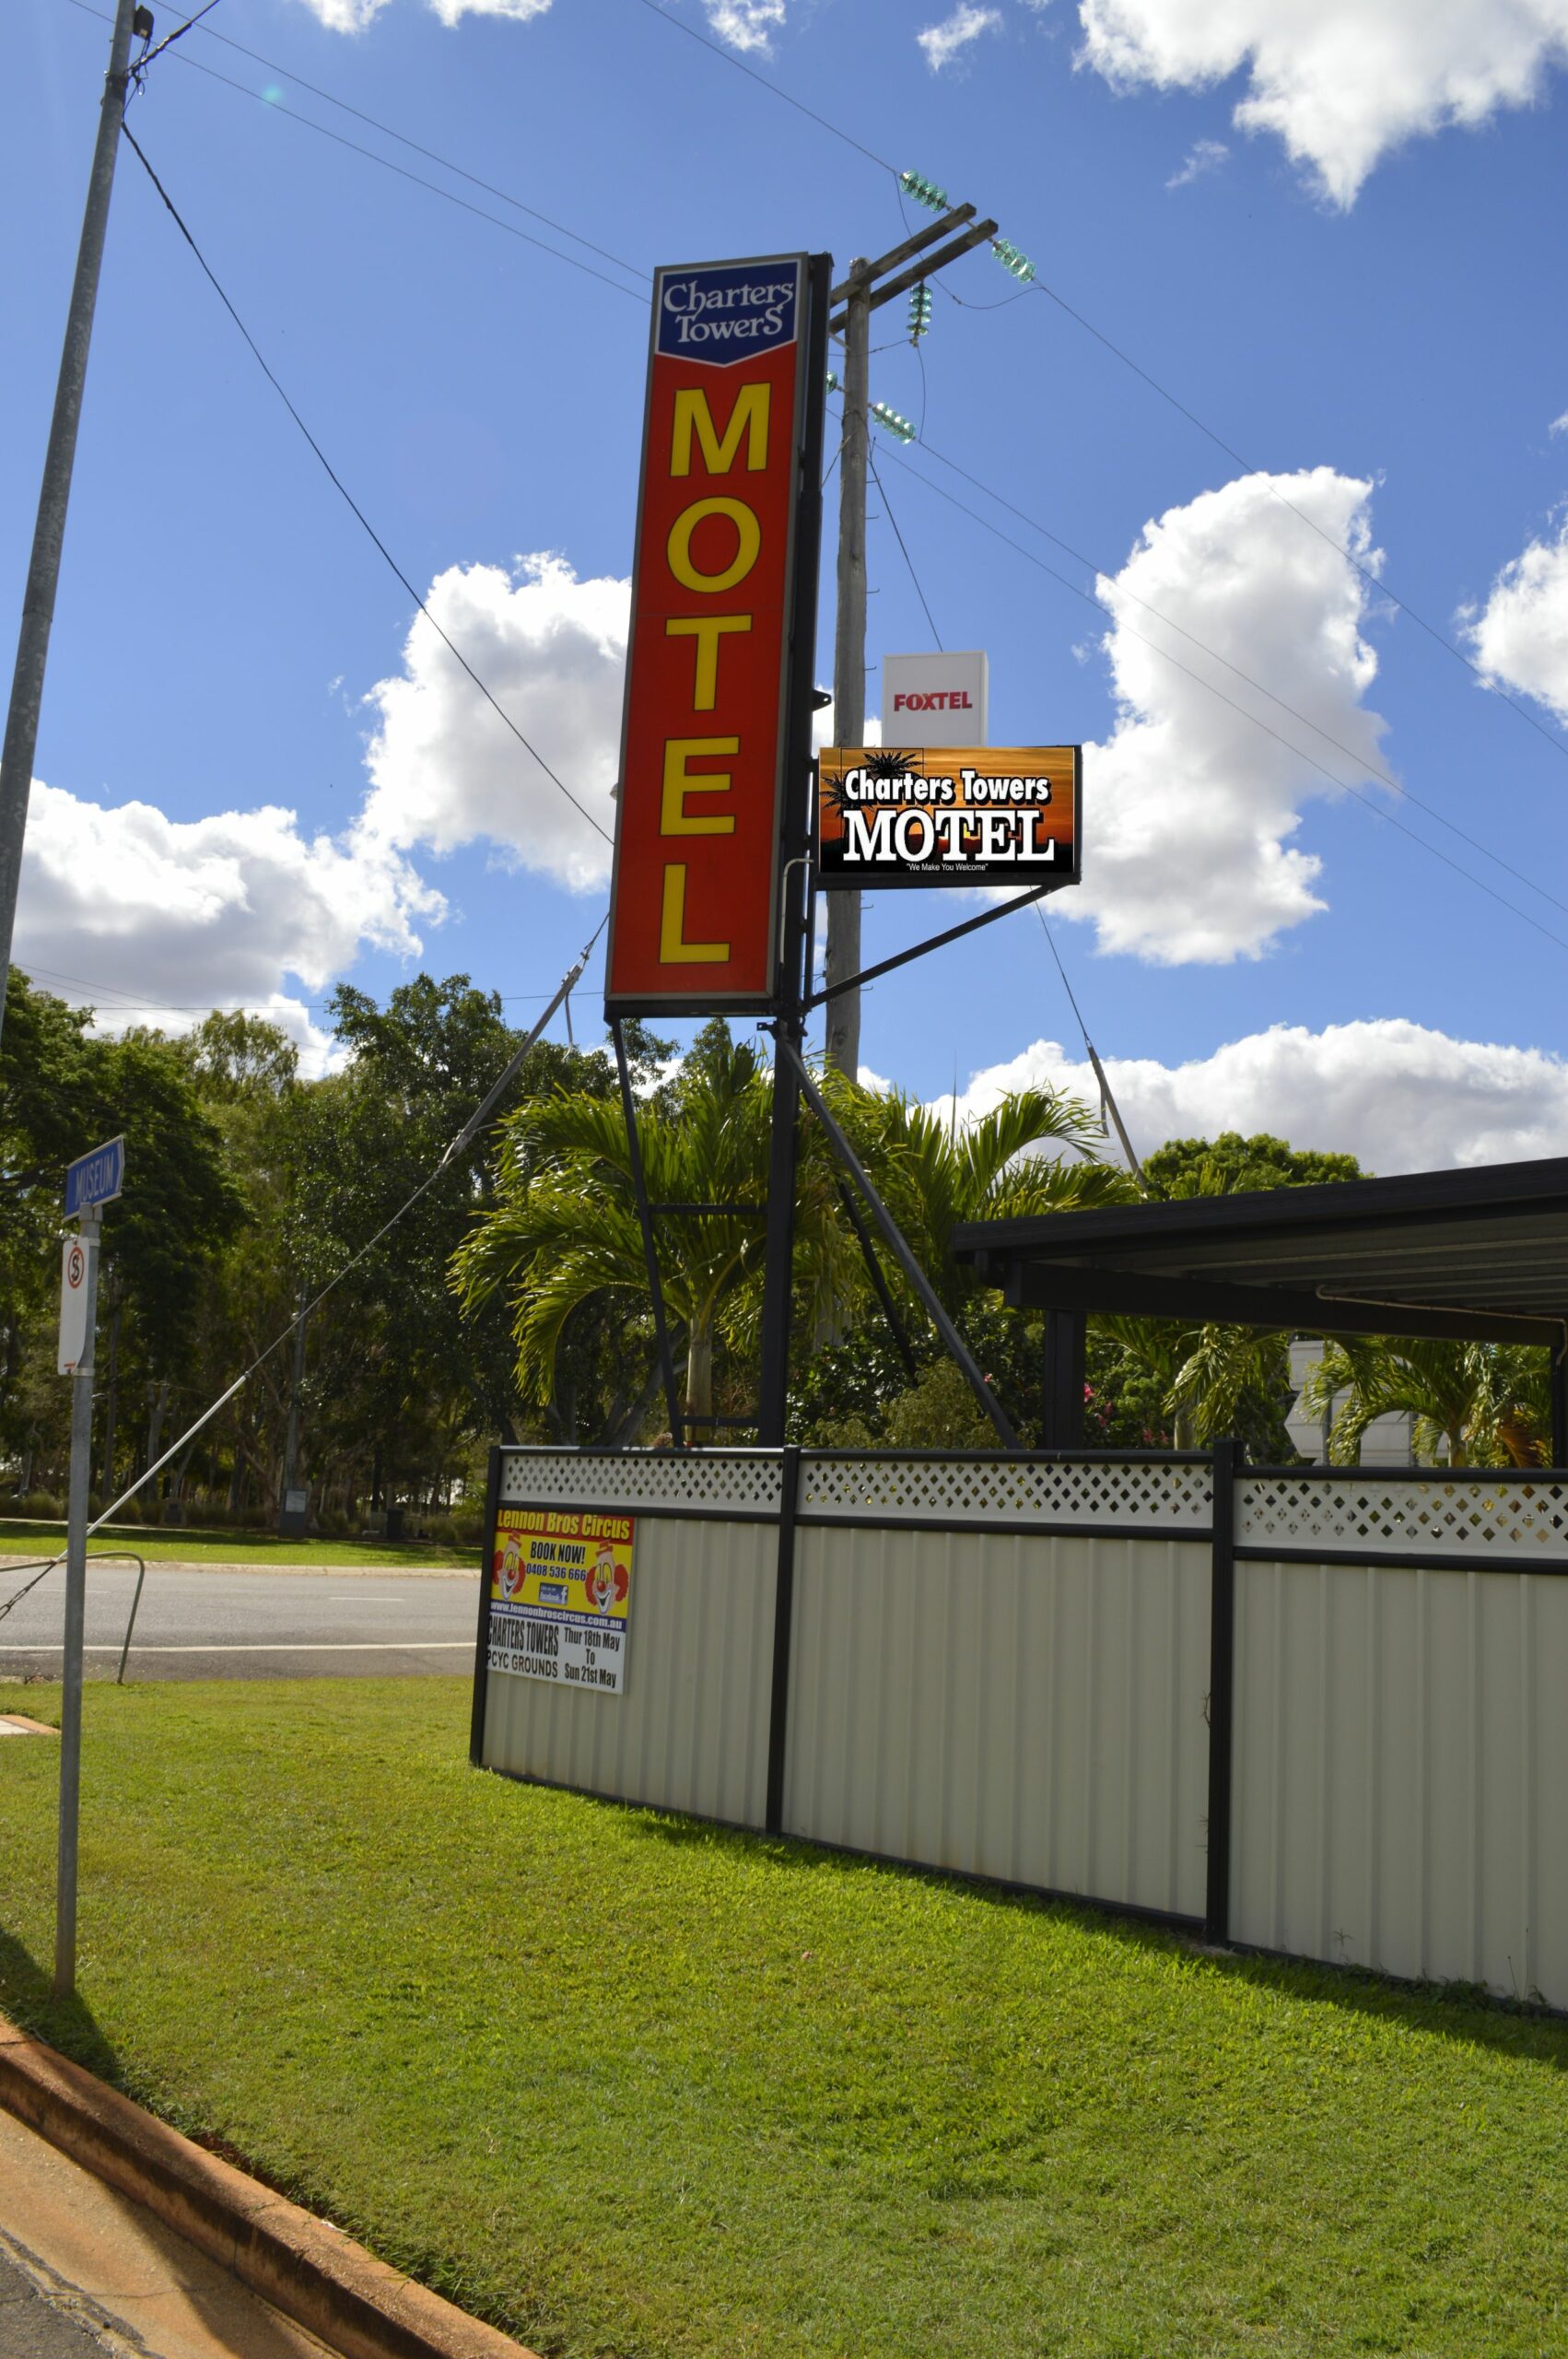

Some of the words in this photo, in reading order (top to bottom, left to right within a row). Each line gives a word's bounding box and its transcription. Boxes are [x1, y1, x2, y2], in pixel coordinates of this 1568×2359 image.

[663, 280, 794, 318] Charters
[659, 381, 772, 964] MOTEL
[894, 691, 973, 712] FOXTEL
[845, 769, 954, 801] Charters
[961, 769, 1049, 801] Towers
[843, 809, 1055, 862] MOTEL
[921, 863, 940, 871] Make
[941, 863, 954, 871] You
[76, 1151, 114, 1206] MUSEUM
[497, 1509, 544, 1532] Lennon
[546, 1512, 579, 1535] Bros
[581, 1515, 630, 1540] Circus
[530, 1542, 556, 1561] BOOK
[557, 1545, 586, 1565] NOW!
[526, 1563, 547, 1576] 0408
[550, 1566, 567, 1579] 536
[568, 1567, 587, 1581] 666
[490, 1602, 623, 1629] www.lennonbroscircus.com.au
[526, 1621, 559, 1657] TOWERS
[564, 1626, 582, 1645] Thur
[584, 1630, 602, 1648] 18th
[603, 1634, 620, 1651] May
[511, 1656, 558, 1678] GROUNDS
[586, 1649, 595, 1665] To
[565, 1662, 580, 1682] Sun
[581, 1667, 598, 1684] 21st
[599, 1672, 616, 1688] May
